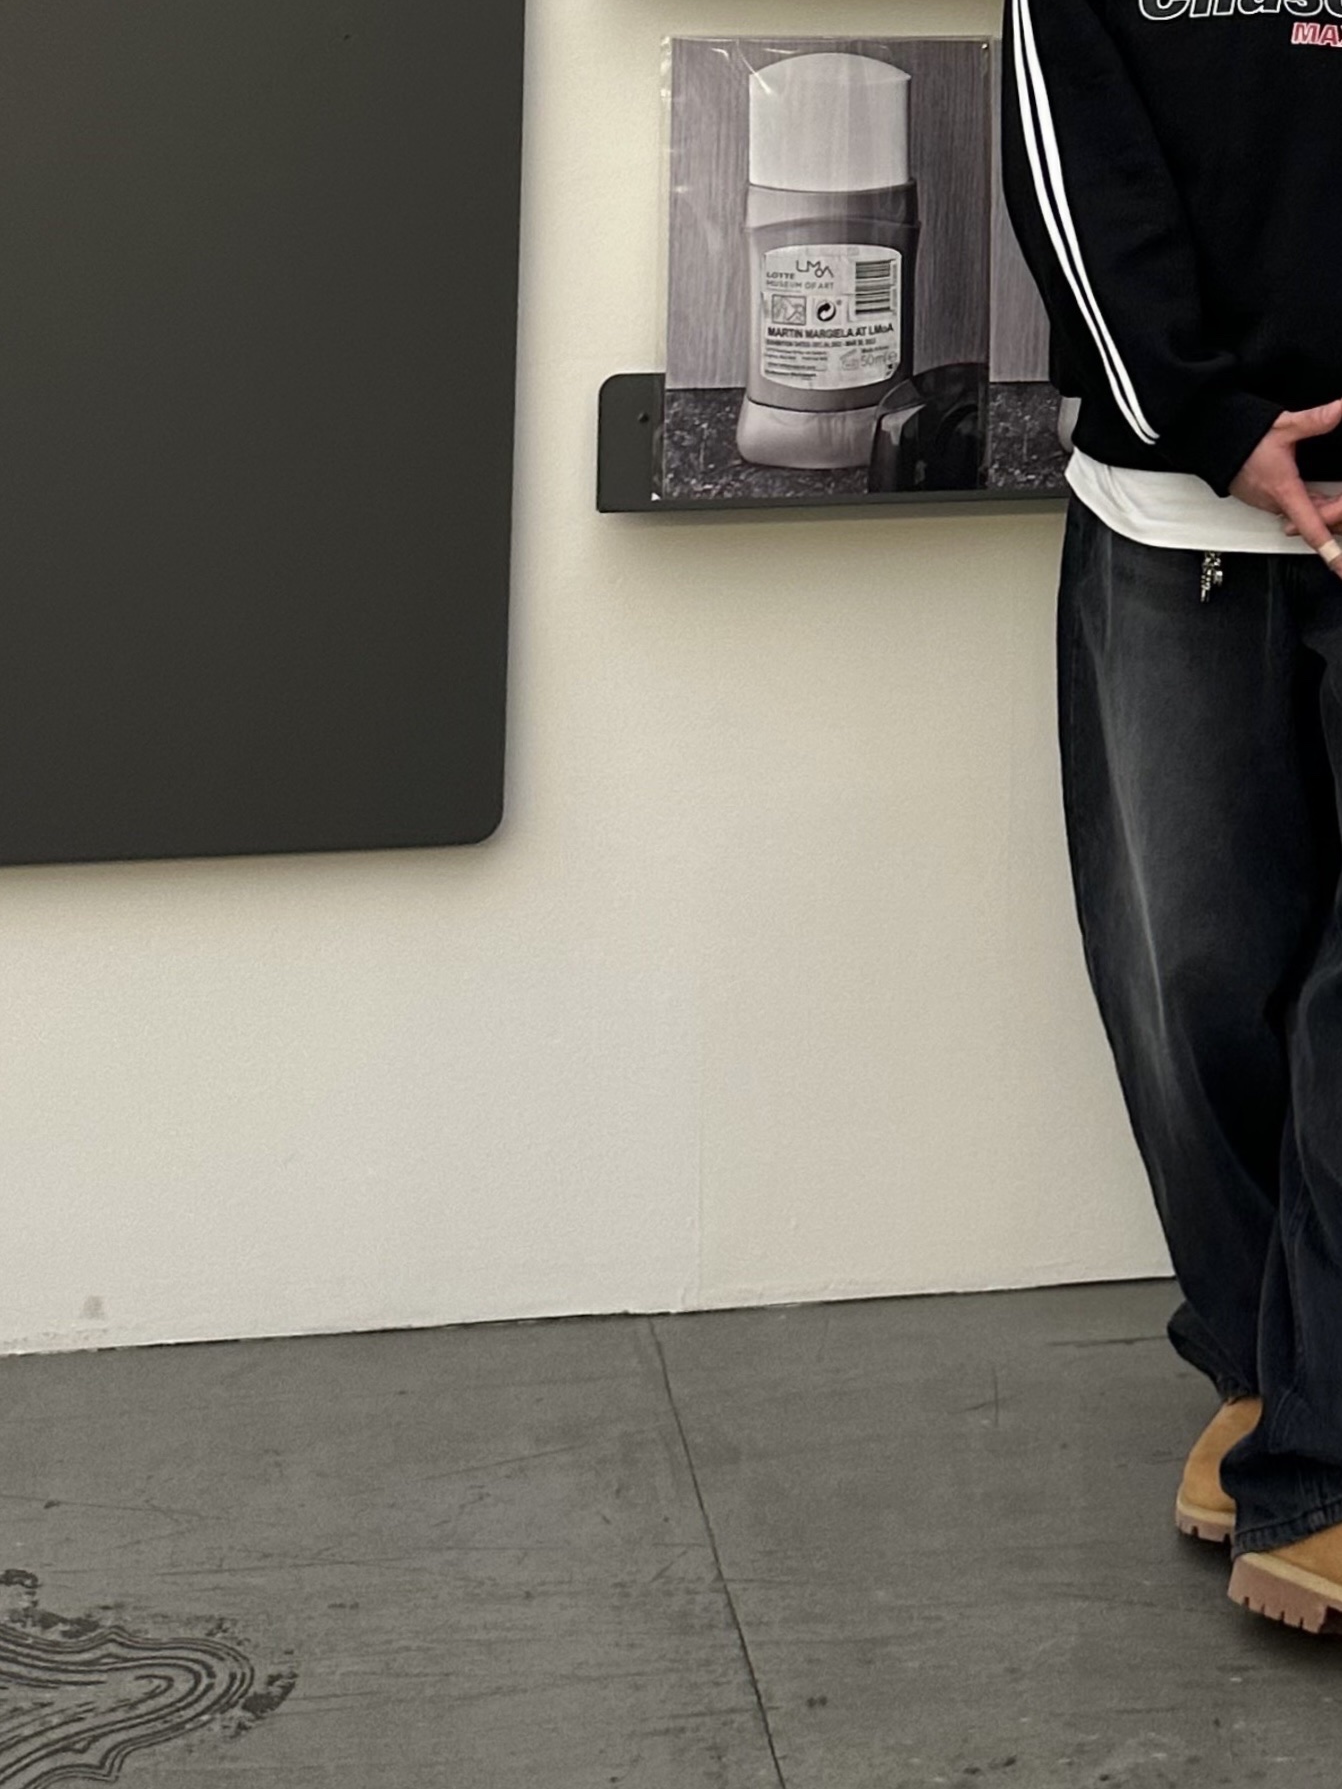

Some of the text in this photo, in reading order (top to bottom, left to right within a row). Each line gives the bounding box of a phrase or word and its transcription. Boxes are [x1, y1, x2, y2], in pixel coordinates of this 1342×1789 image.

[766, 271, 795, 280] LOTTE
[766, 279, 802, 288] MUSEUM
[767, 327, 803, 338] MARTIN
[805, 327, 854, 339] MARGIELA
[855, 326, 867, 336] AT
